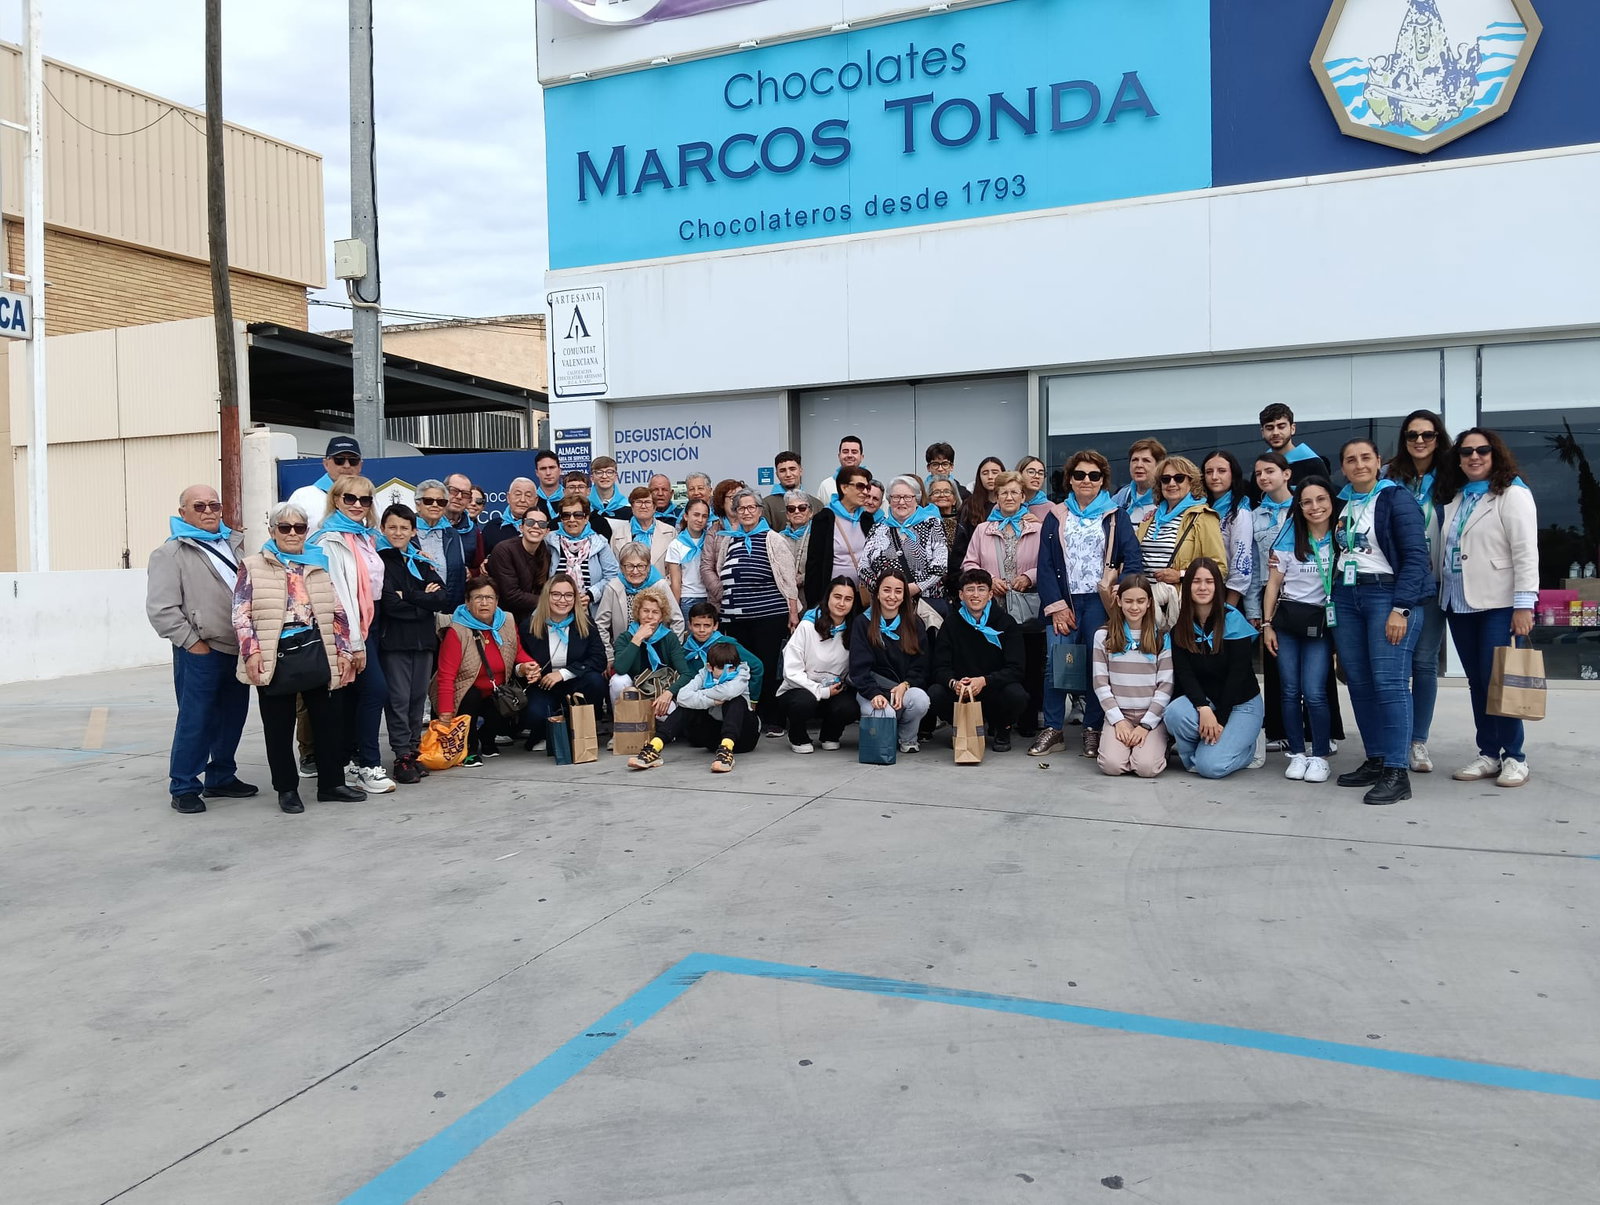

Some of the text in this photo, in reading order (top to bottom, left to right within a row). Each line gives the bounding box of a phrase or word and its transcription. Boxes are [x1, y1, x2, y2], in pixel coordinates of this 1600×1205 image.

[724, 42, 967, 112] Chocolates
[577, 70, 1160, 202] MARCOS TONDA
[678, 173, 1028, 242] Chocolateros desde 1793
[562, 345, 596, 356] COMUNITAT
[561, 357, 599, 368] VALENCIANA
[614, 421, 712, 444] DEGUSTACIÓN
[558, 446, 589, 456] ALMACEN
[615, 442, 699, 464] EXPOSICIÓN
